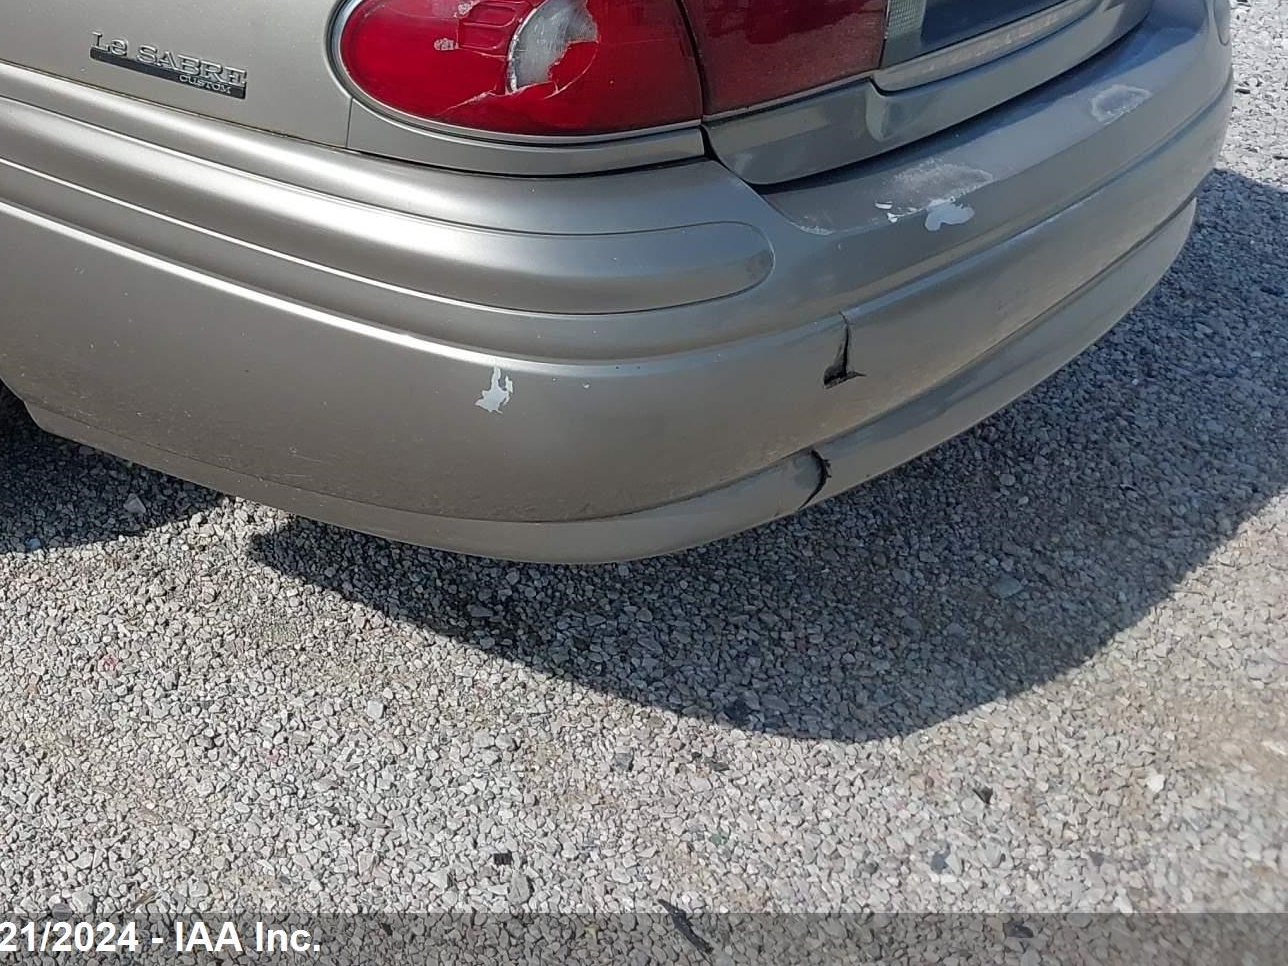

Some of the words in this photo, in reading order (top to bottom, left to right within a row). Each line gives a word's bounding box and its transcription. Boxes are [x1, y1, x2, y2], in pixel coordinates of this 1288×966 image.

[90, 31, 128, 56] Le
[136, 44, 247, 87] SABRE
[178, 73, 232, 95] CUSTOM
